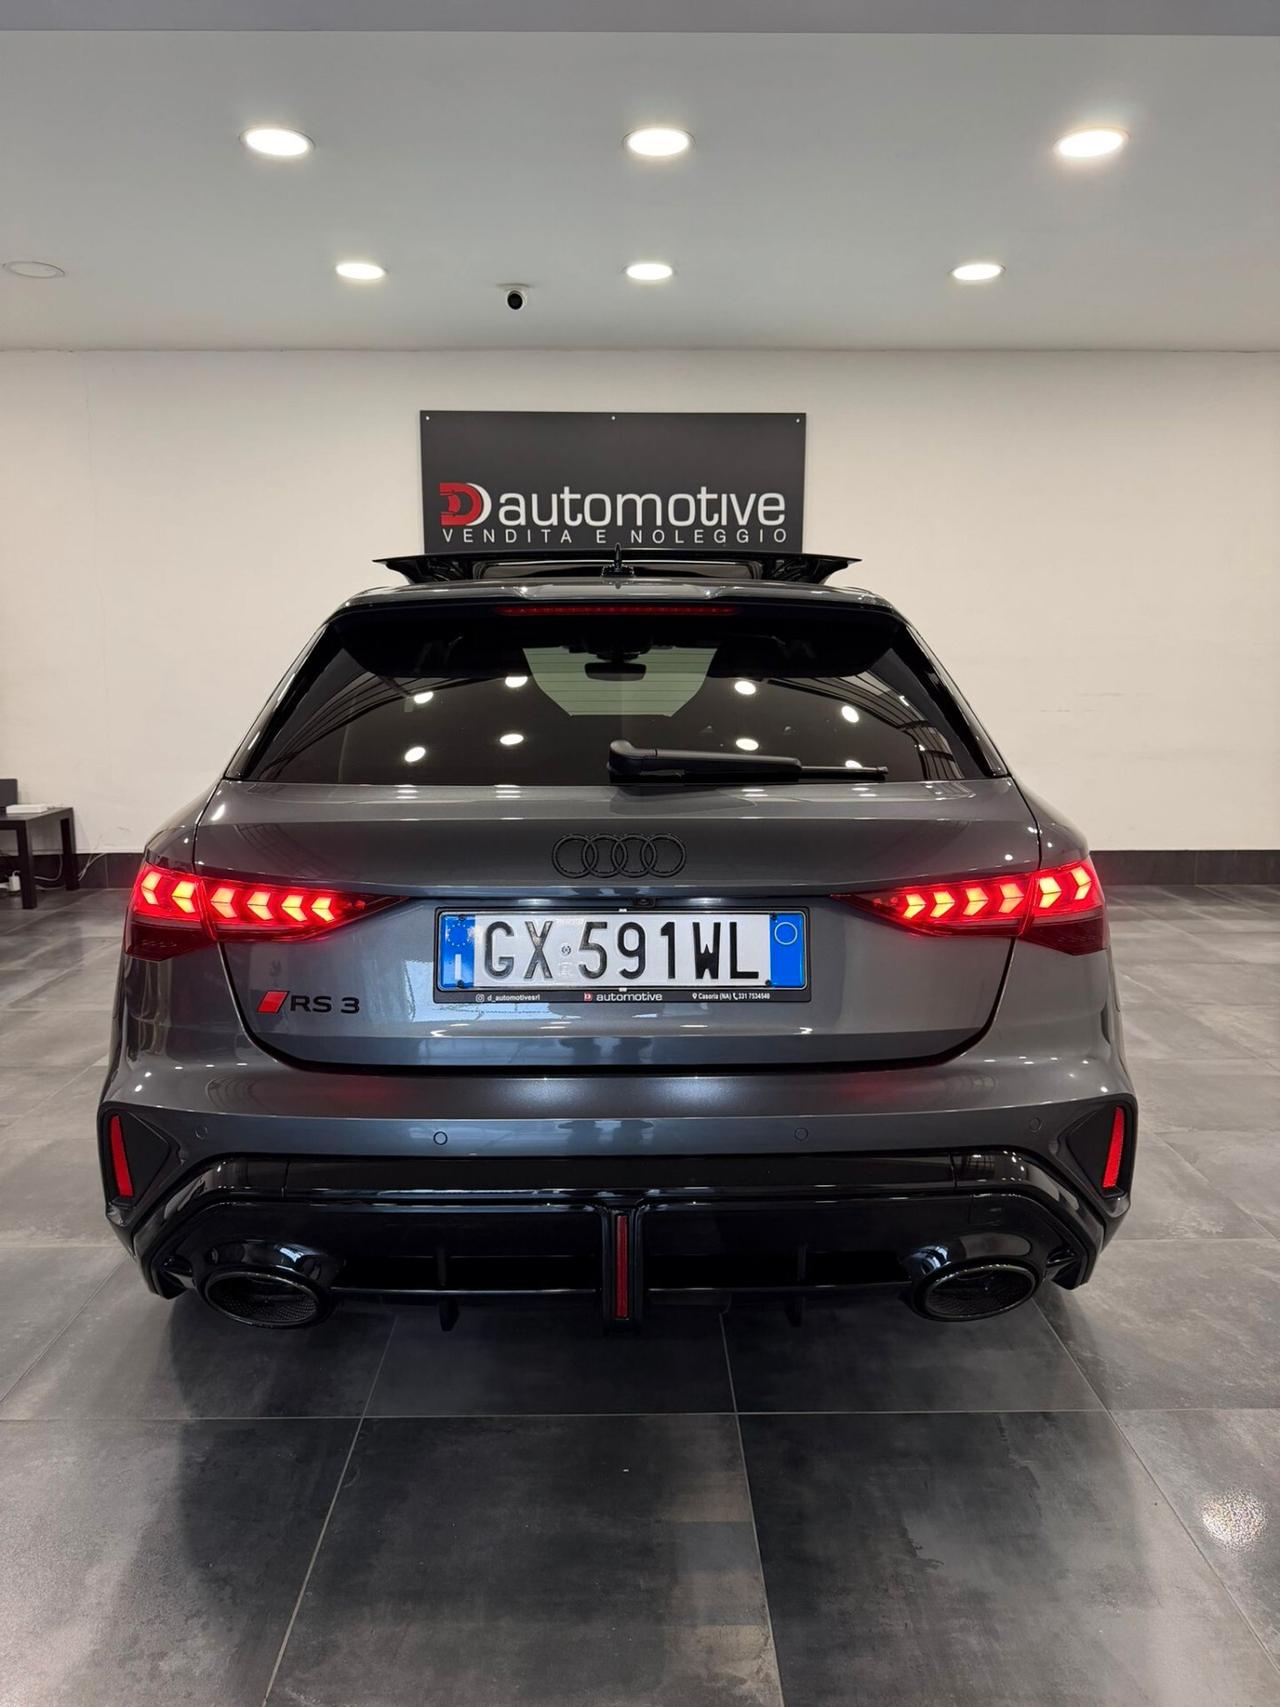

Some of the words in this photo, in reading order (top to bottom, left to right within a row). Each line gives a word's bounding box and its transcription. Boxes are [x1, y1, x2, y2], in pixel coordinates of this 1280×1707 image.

[498, 486, 786, 527] automotive
[442, 528, 573, 544] VENDITA
[596, 529, 606, 544] E
[630, 529, 787, 544] NOLEGGIO
[596, 992, 663, 1002] automotive
[698, 992, 719, 1000] Casoria
[290, 995, 332, 1013] RS
[340, 997, 360, 1014] 3
